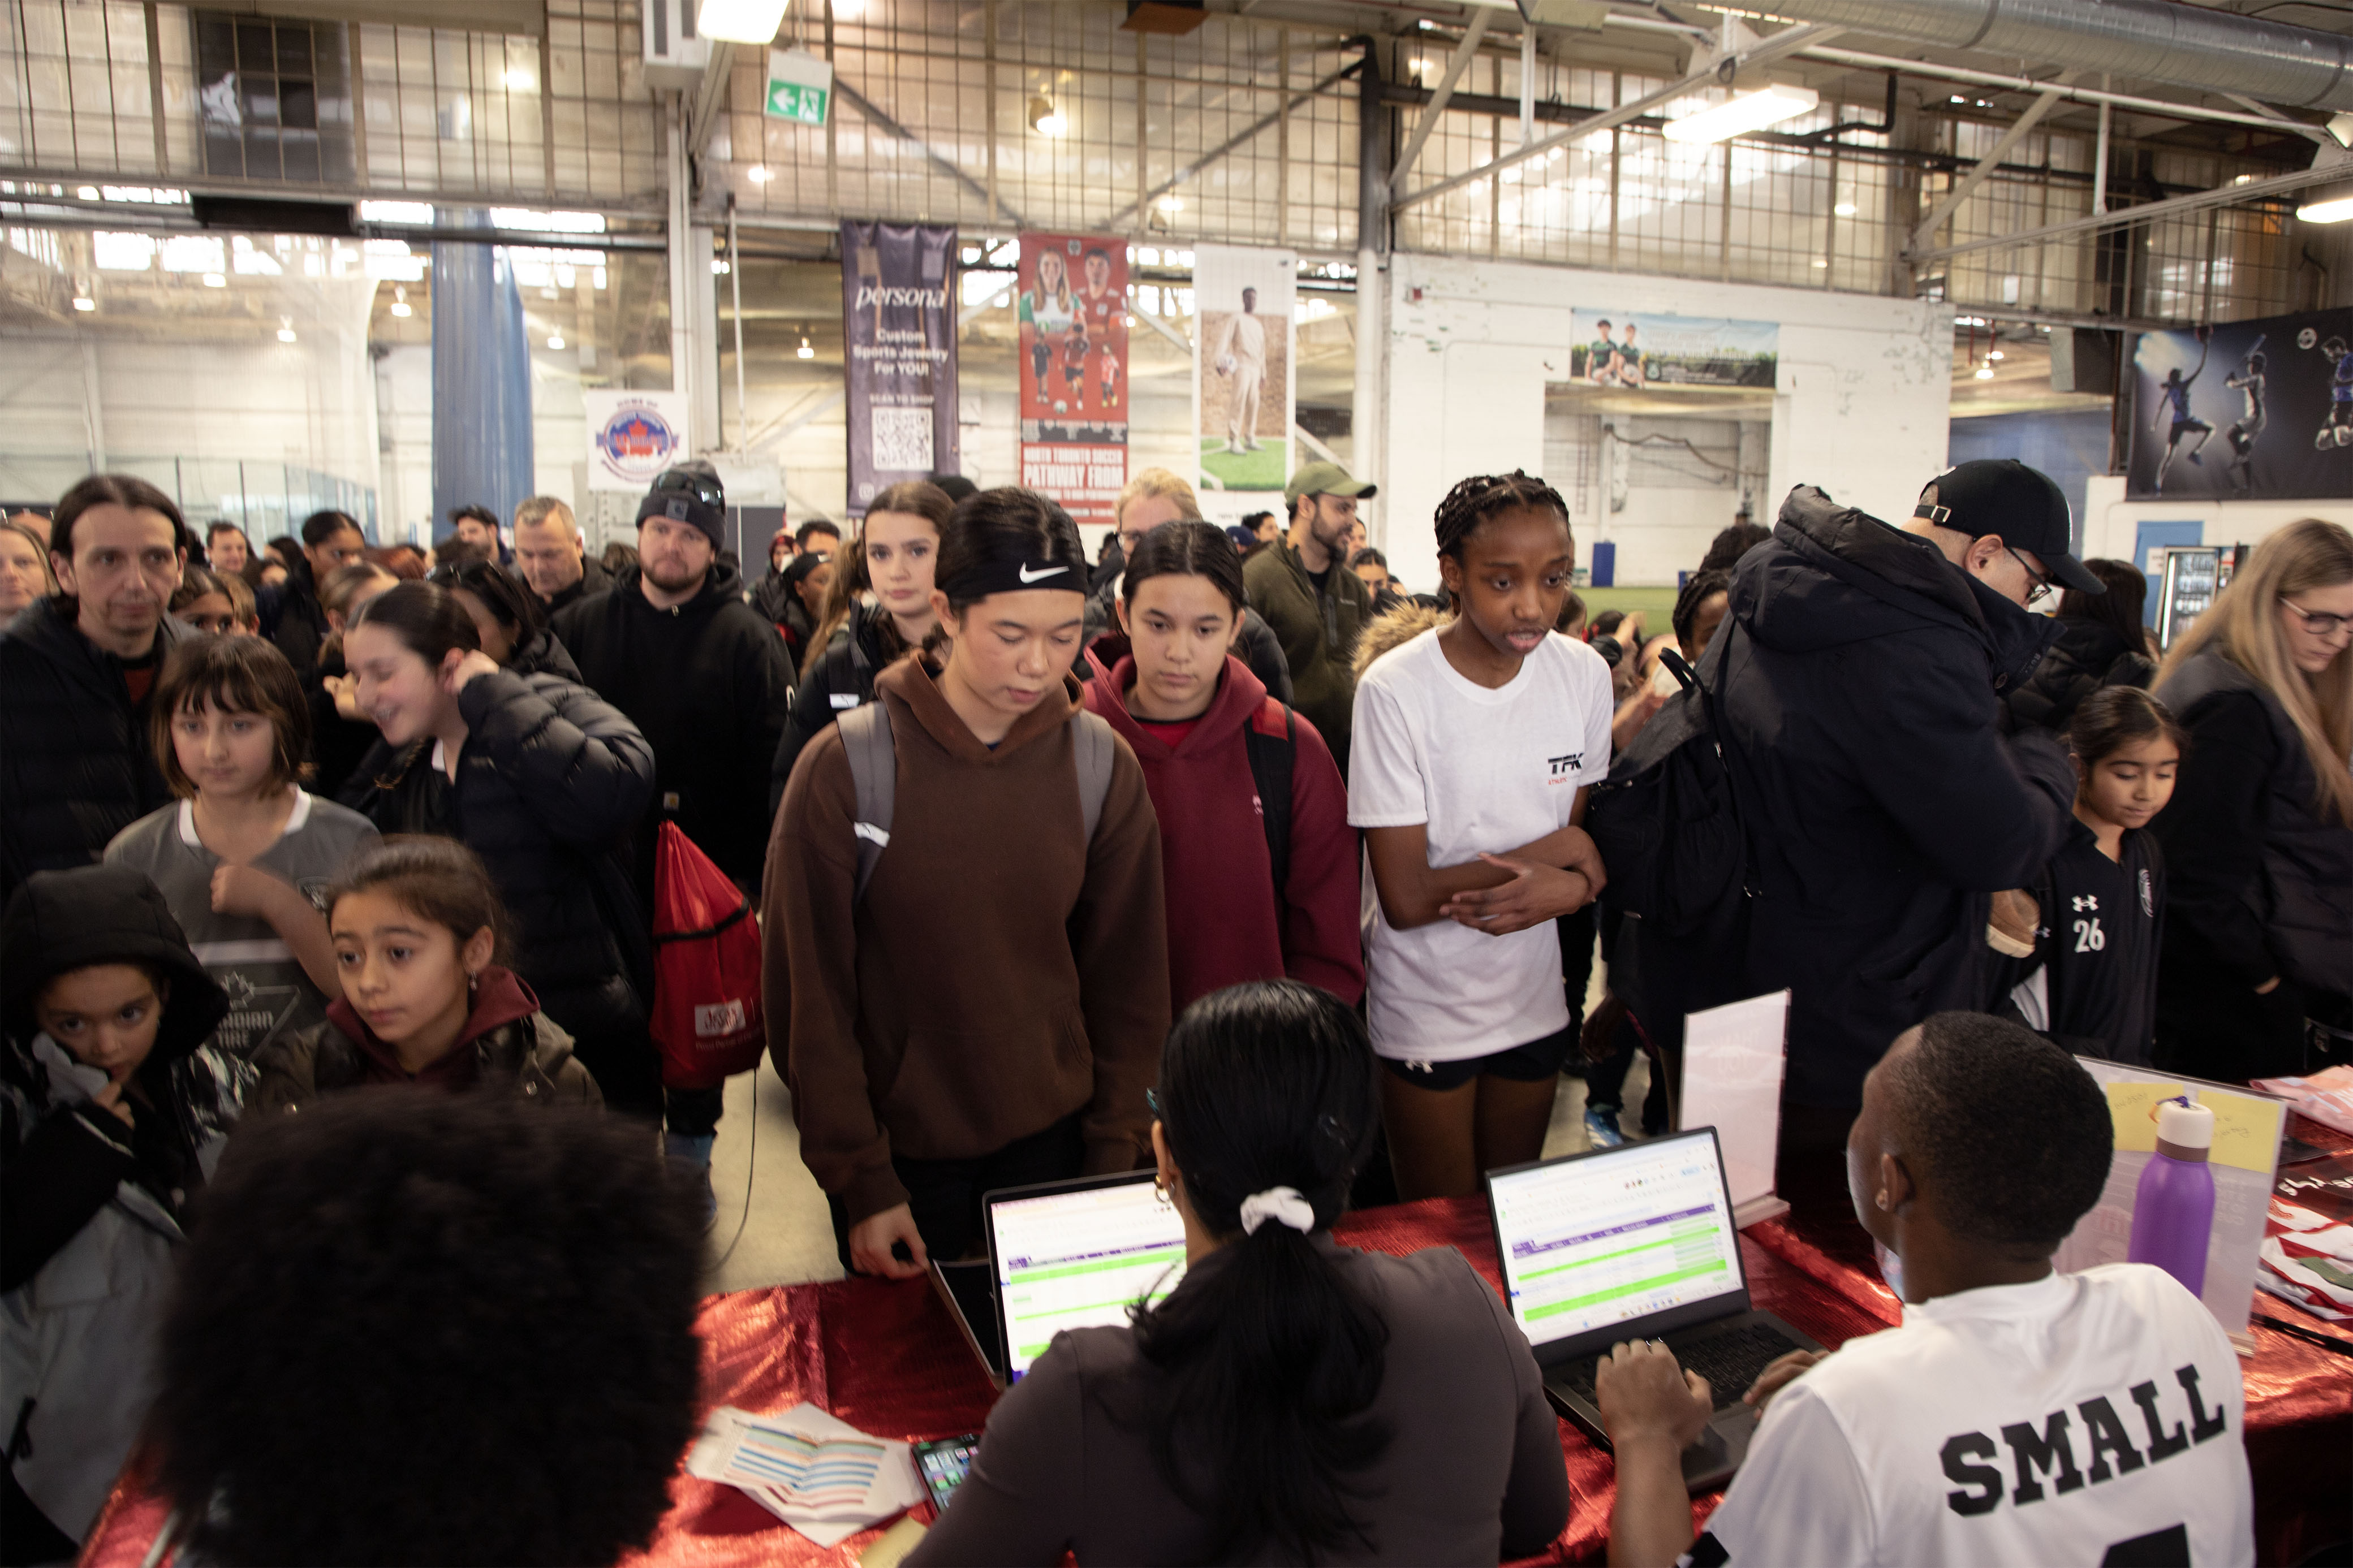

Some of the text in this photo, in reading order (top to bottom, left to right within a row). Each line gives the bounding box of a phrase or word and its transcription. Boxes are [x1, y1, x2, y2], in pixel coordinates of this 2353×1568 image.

[855, 286, 946, 310] persona
[876, 327, 926, 343] Custom
[853, 344, 949, 363] Sports Jewelry
[874, 361, 895, 375] For
[1024, 464, 1124, 489] PATHWAY FROM
[2072, 917, 2105, 953] 26
[1940, 1364, 2227, 1518] SMALL
